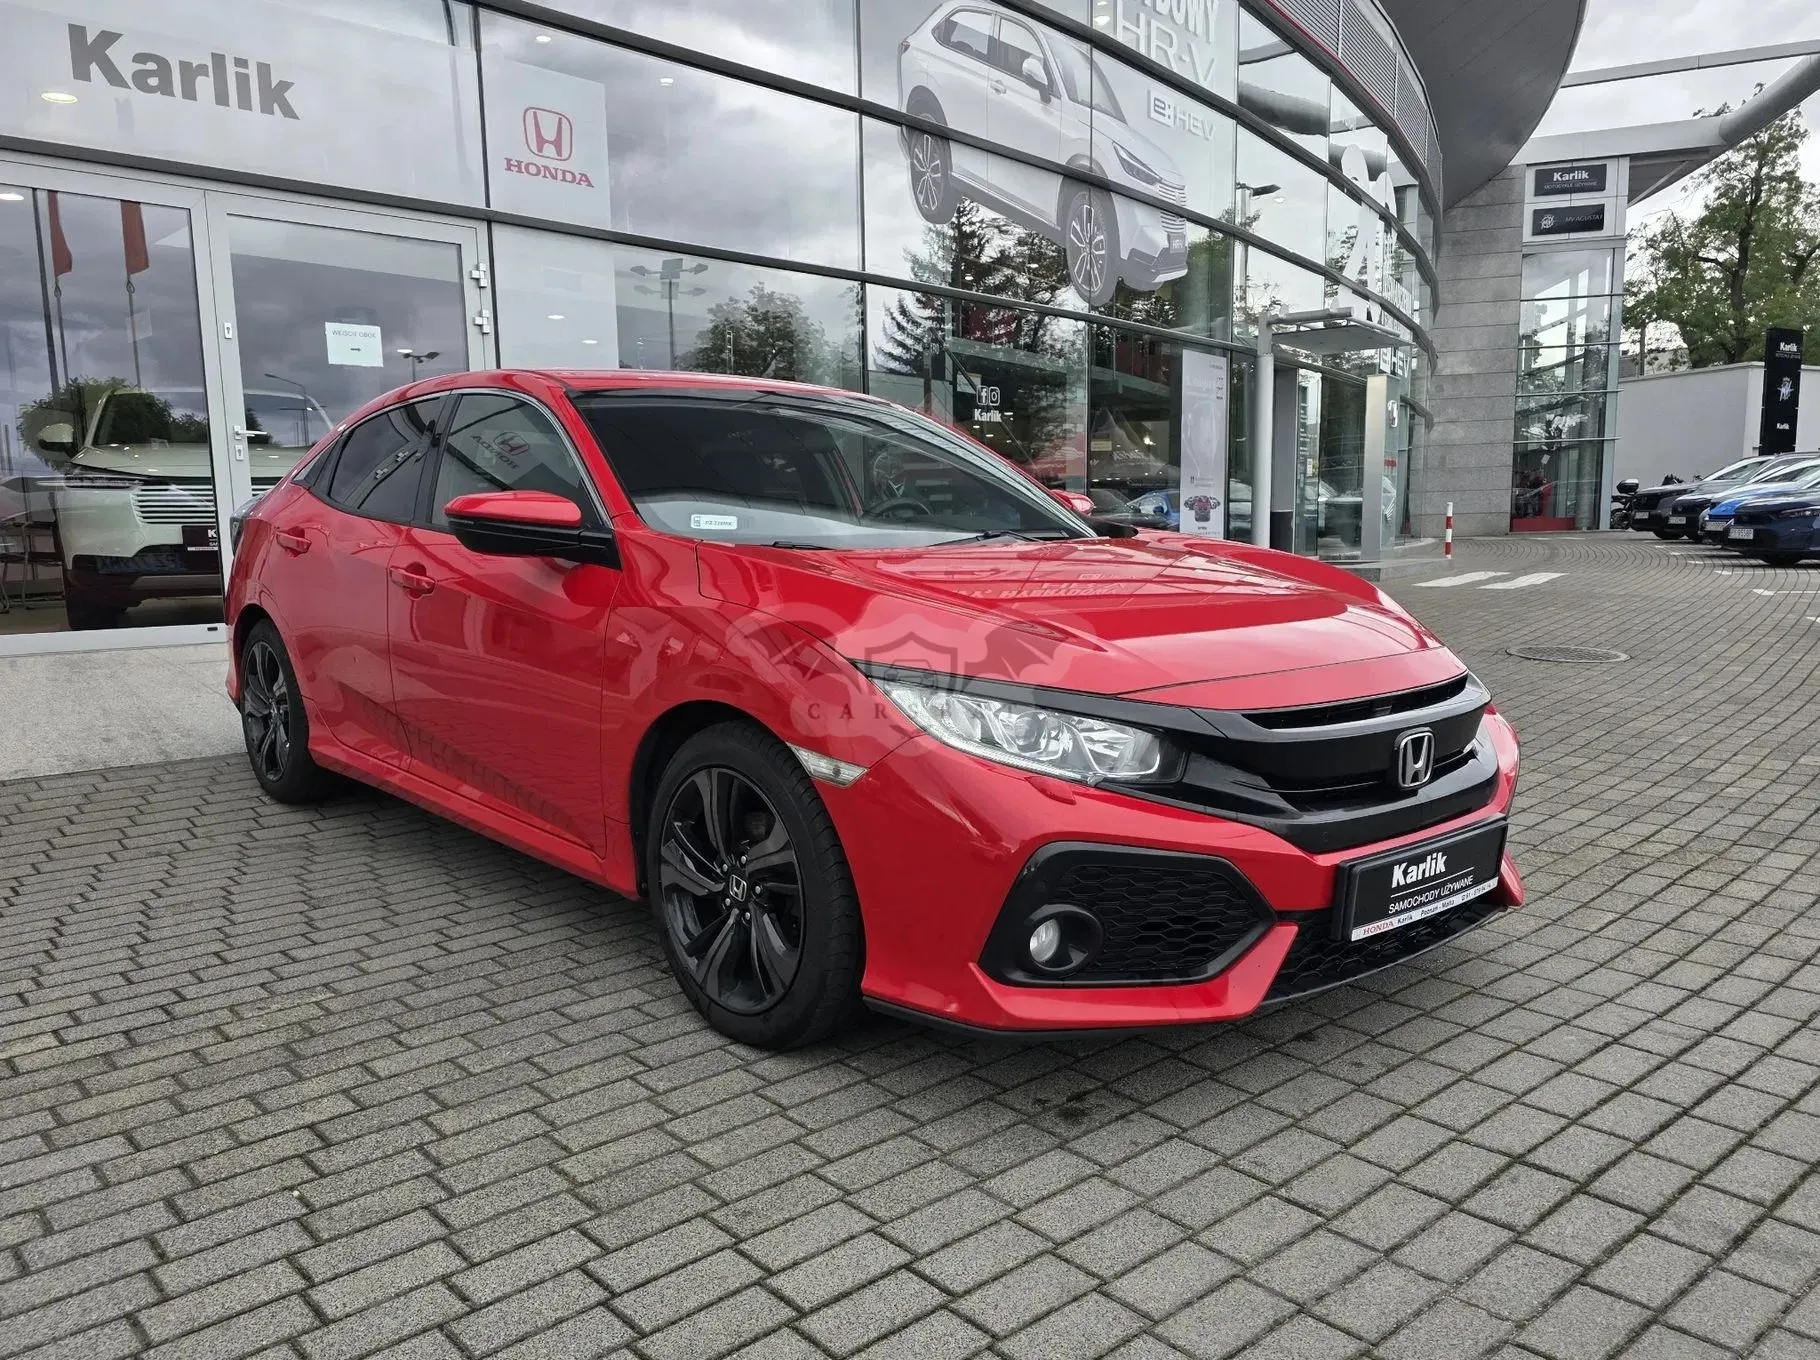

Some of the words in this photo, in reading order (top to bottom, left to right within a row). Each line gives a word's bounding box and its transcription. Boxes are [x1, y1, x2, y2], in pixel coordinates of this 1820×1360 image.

[67, 22, 301, 121] Karlik
[503, 157, 595, 188] HONDA
[1553, 170, 1589, 182] Karlik
[1780, 341, 1798, 352] Karlik
[974, 408, 1002, 423] Karlik
[1391, 852, 1447, 888] Karlik
[1388, 888, 1440, 914] SAMOCHODY
[1440, 875, 1474, 896] UŻYWANE
[1363, 921, 1394, 935] HONDA
[1397, 914, 1413, 924] Karlik
